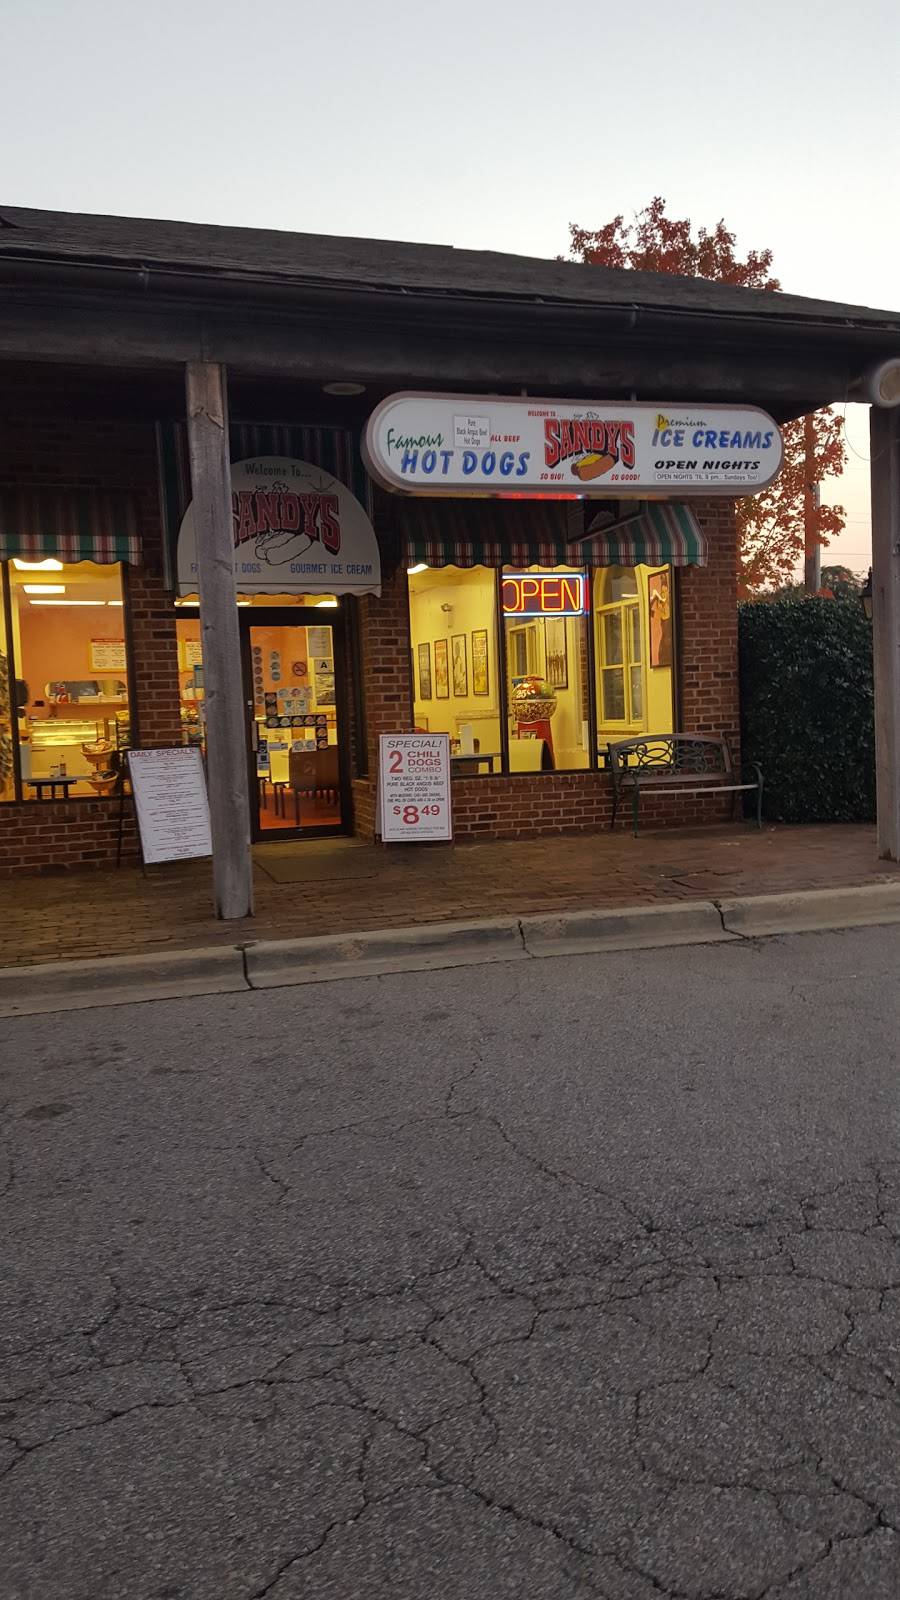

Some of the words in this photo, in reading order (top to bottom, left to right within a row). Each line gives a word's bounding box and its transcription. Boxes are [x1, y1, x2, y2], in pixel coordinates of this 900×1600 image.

[656, 414, 707, 429] Premium
[468, 428, 478, 436] Angus
[386, 428, 444, 456] Famous
[652, 428, 686, 448] ICE
[692, 430, 774, 449] CREAMS
[400, 450, 454, 475] HOT
[462, 450, 530, 476] DOGS
[654, 460, 698, 470] OPEN
[702, 460, 760, 470] NIGHTS
[244, 464, 288, 476] Welcome
[241, 563, 262, 574] DOGS
[290, 564, 326, 574] GOURMET
[330, 564, 344, 574] ICE
[346, 564, 372, 575] CREAM
[502, 578, 580, 612] OPEN
[387, 740, 442, 748] SPECIAL!
[130, 750, 152, 758] DAILY
[156, 748, 196, 756] SPECIALS
[389, 750, 404, 774] 2
